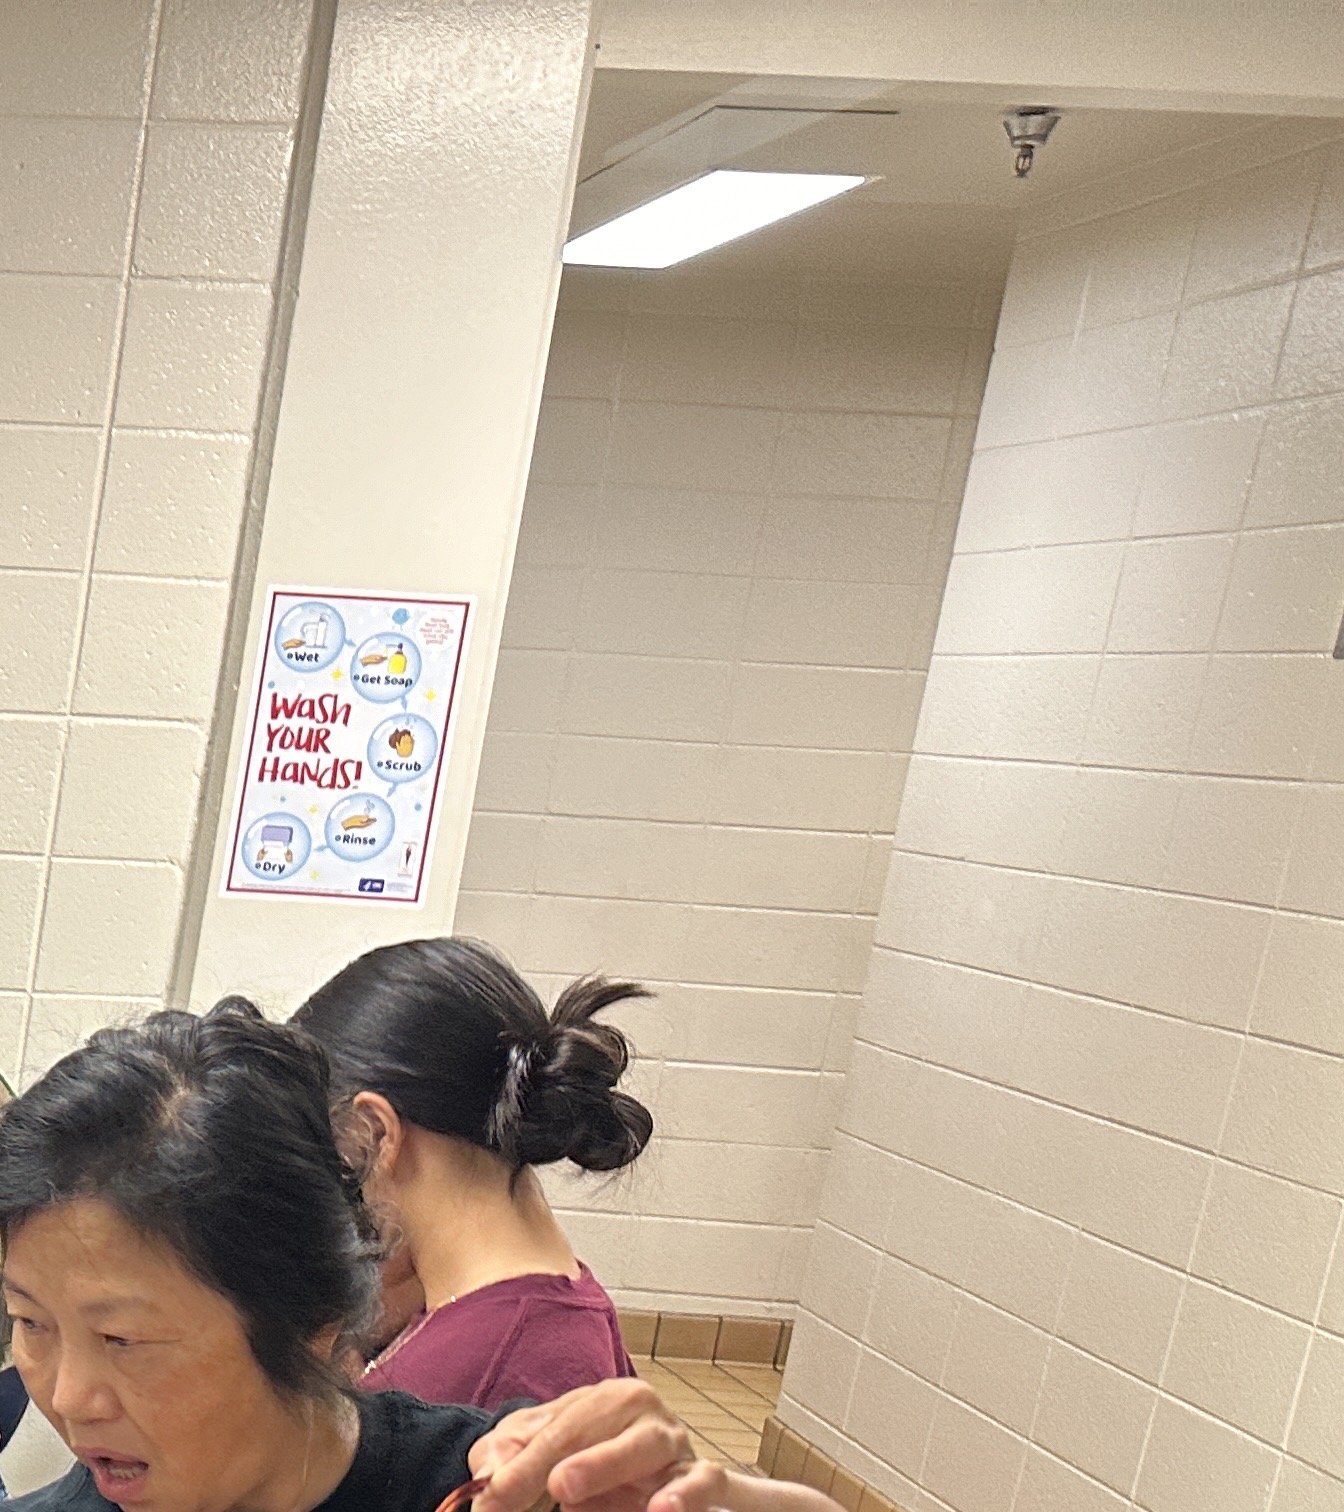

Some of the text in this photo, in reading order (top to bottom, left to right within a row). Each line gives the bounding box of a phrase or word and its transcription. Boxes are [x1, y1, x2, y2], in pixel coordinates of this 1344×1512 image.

[294, 652, 320, 664] Wet
[360, 673, 413, 688] Get Soap
[265, 723, 332, 755] YOUR
[384, 760, 422, 773] Scrub
[342, 833, 377, 846] Rinse
[261, 861, 286, 875] Dry
